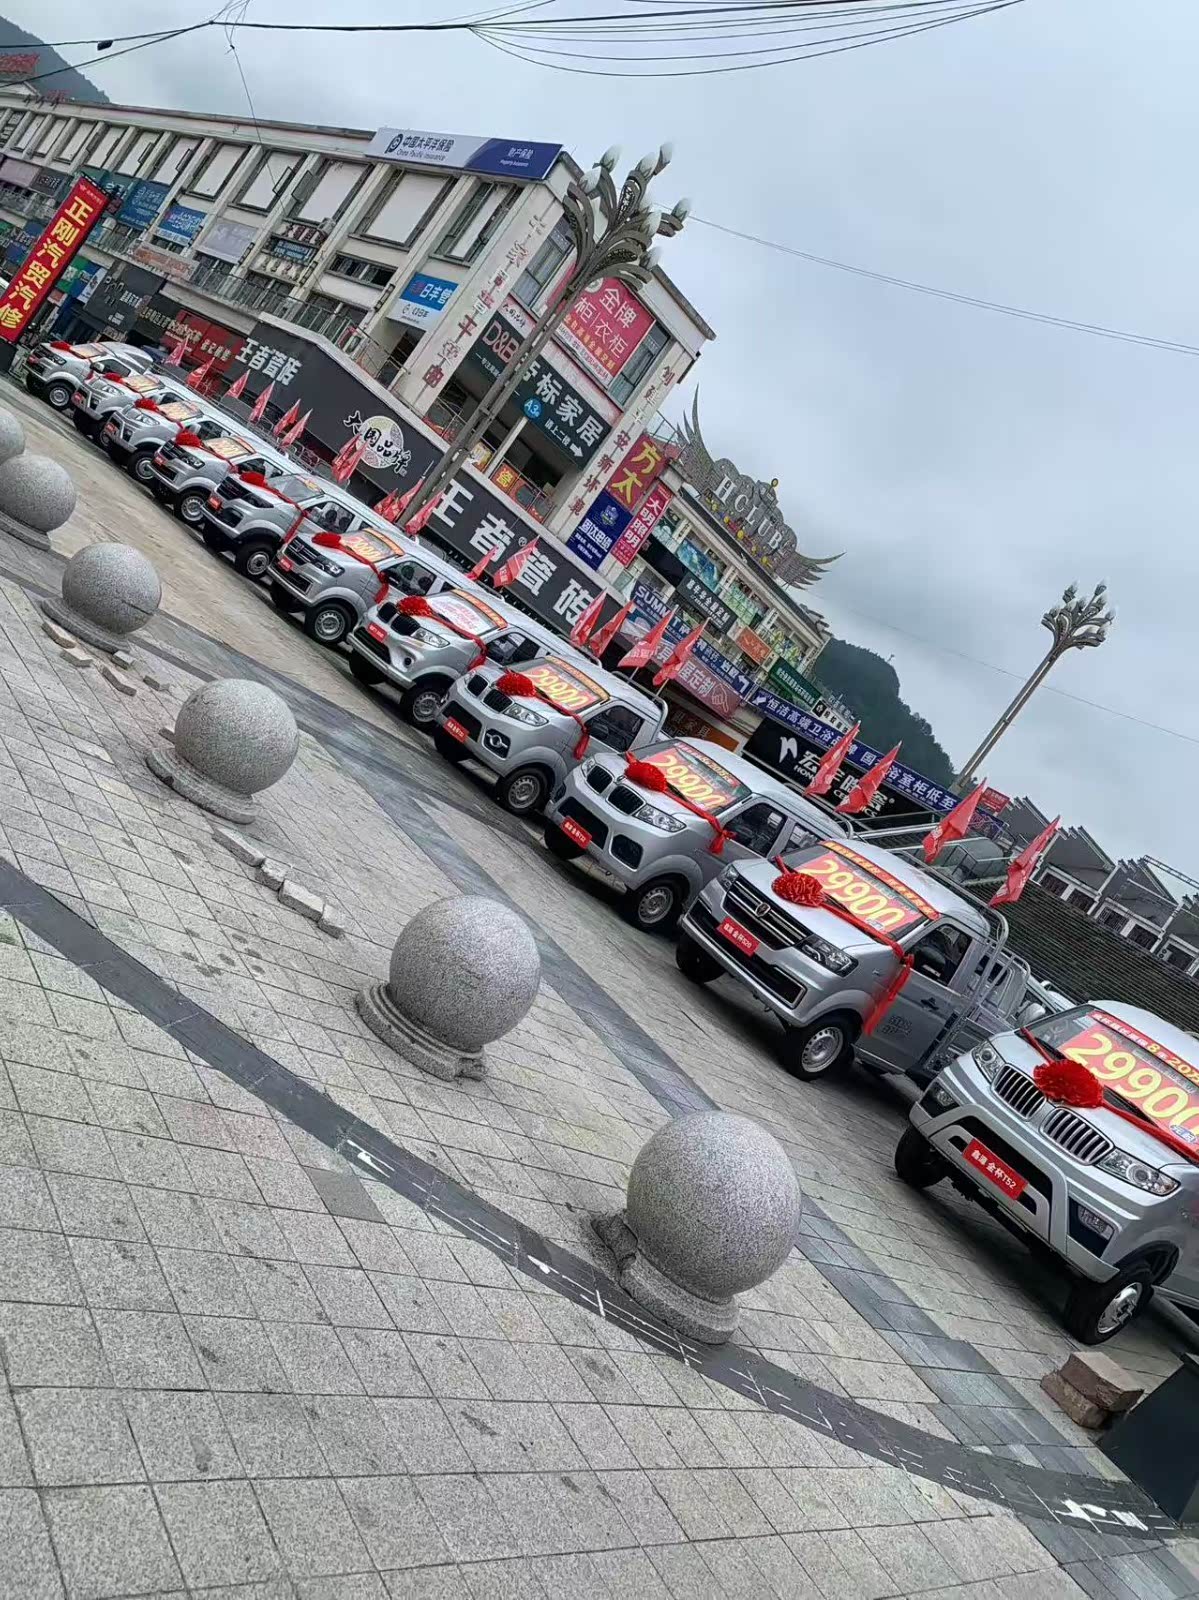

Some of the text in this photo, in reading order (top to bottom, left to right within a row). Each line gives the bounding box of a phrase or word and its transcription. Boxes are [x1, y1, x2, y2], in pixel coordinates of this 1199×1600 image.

[401, 134, 455, 152] 中国太平洋保险
[0, 195, 94, 328] 正刚汽贸汽修
[573, 296, 630, 359] 柜|衣柜
[601, 286, 638, 330] 金牌
[482, 320, 522, 364] D&B
[611, 441, 661, 504] 方太
[624, 497, 665, 549] 大明照明
[635, 585, 682, 628] SUMMT
[860, 750, 957, 811] 国浴室柜低至
[800, 857, 904, 929] 29900
